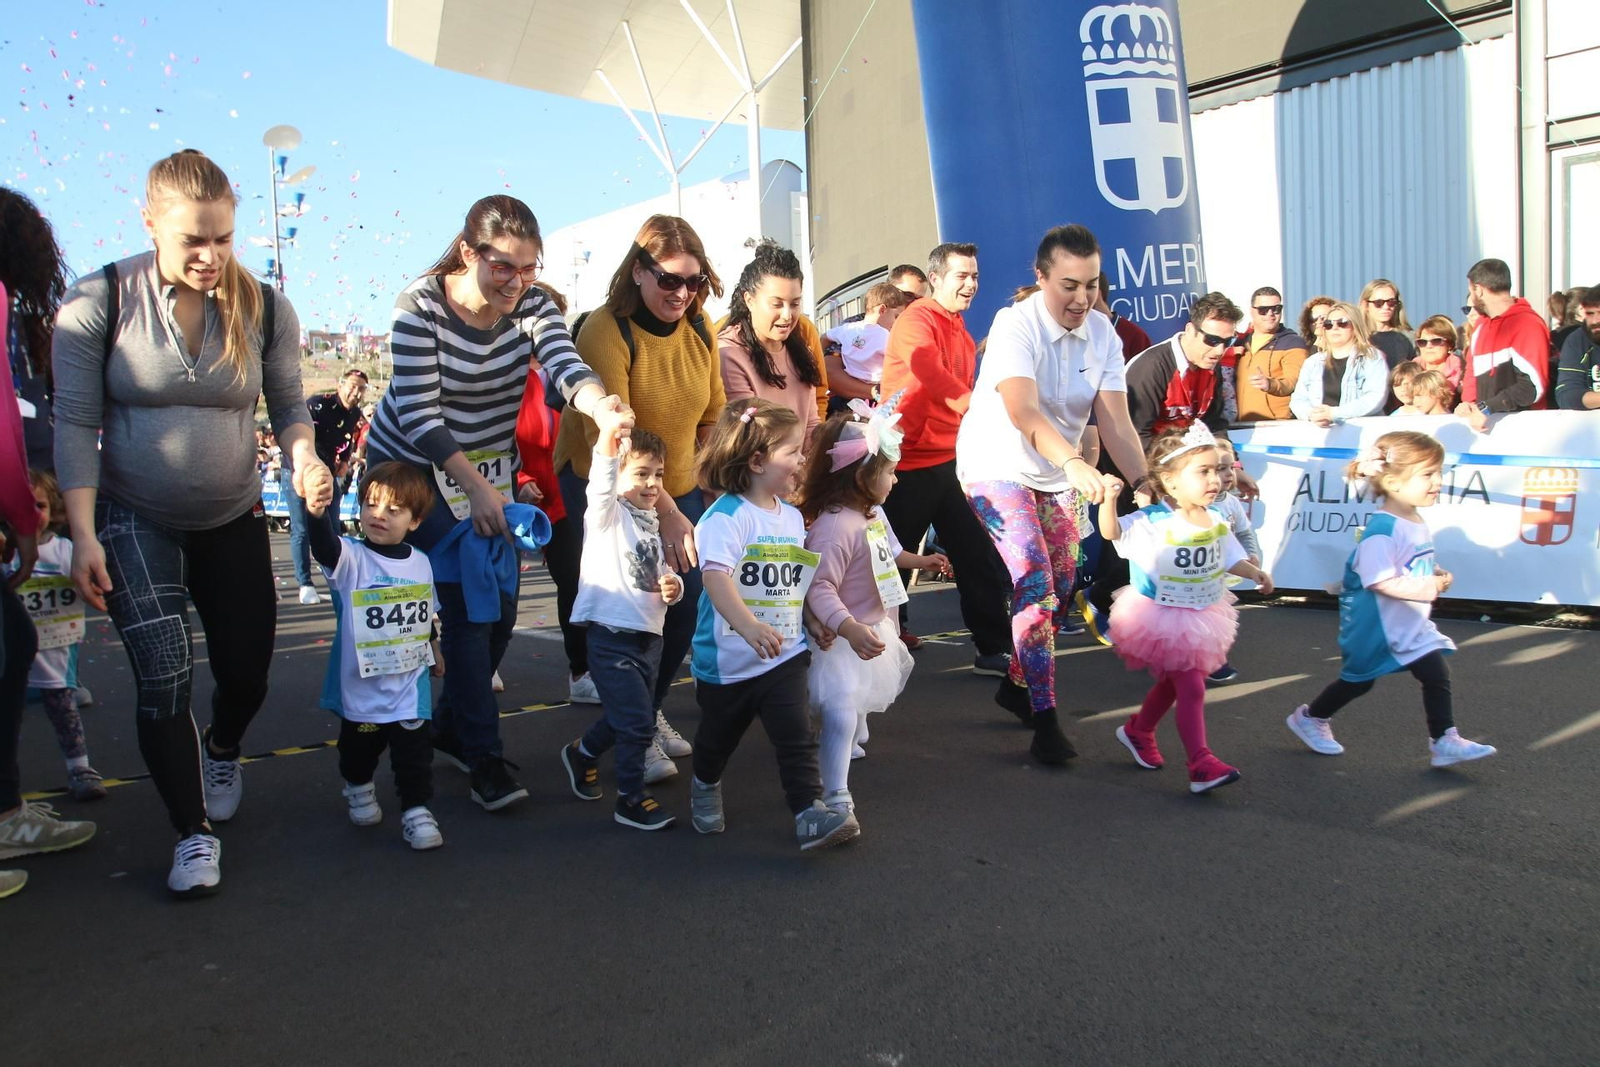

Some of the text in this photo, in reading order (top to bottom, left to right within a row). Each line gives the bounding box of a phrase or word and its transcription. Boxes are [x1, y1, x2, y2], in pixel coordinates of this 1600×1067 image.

[1108, 234, 1206, 291] MERÍ
[1292, 464, 1490, 506] ALMÍA
[375, 575, 399, 584] SUPER
[740, 562, 803, 588] 8004
[20, 588, 76, 611] 319
[366, 601, 428, 629] 8428
